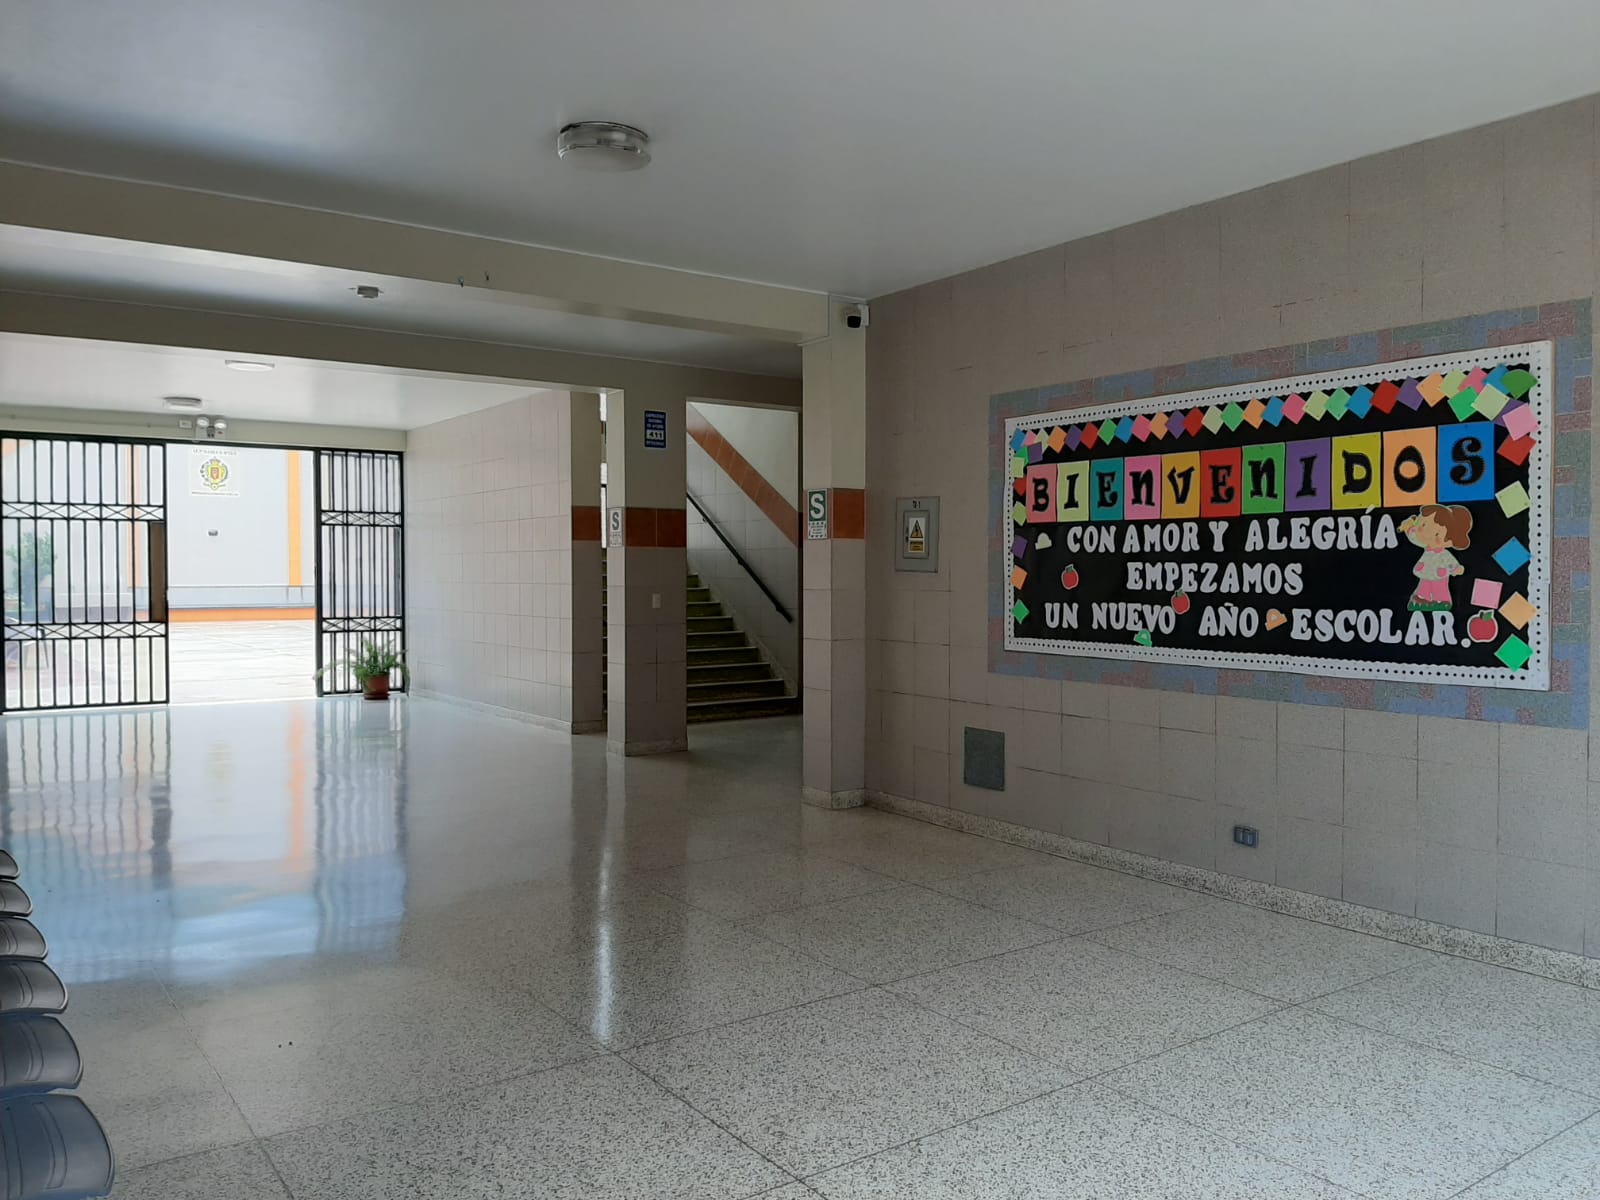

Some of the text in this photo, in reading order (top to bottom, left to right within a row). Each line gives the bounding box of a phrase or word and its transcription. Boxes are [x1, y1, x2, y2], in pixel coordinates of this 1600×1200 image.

[611, 511, 620, 531] S
[810, 493, 825, 519] S
[1067, 504, 1399, 553] CON AMOR Y ALEGRÍA
[1126, 561, 1304, 596] EMPEZAMOS
[1044, 601, 1472, 648] UN NUEVO AÑO ESCOLAR.
